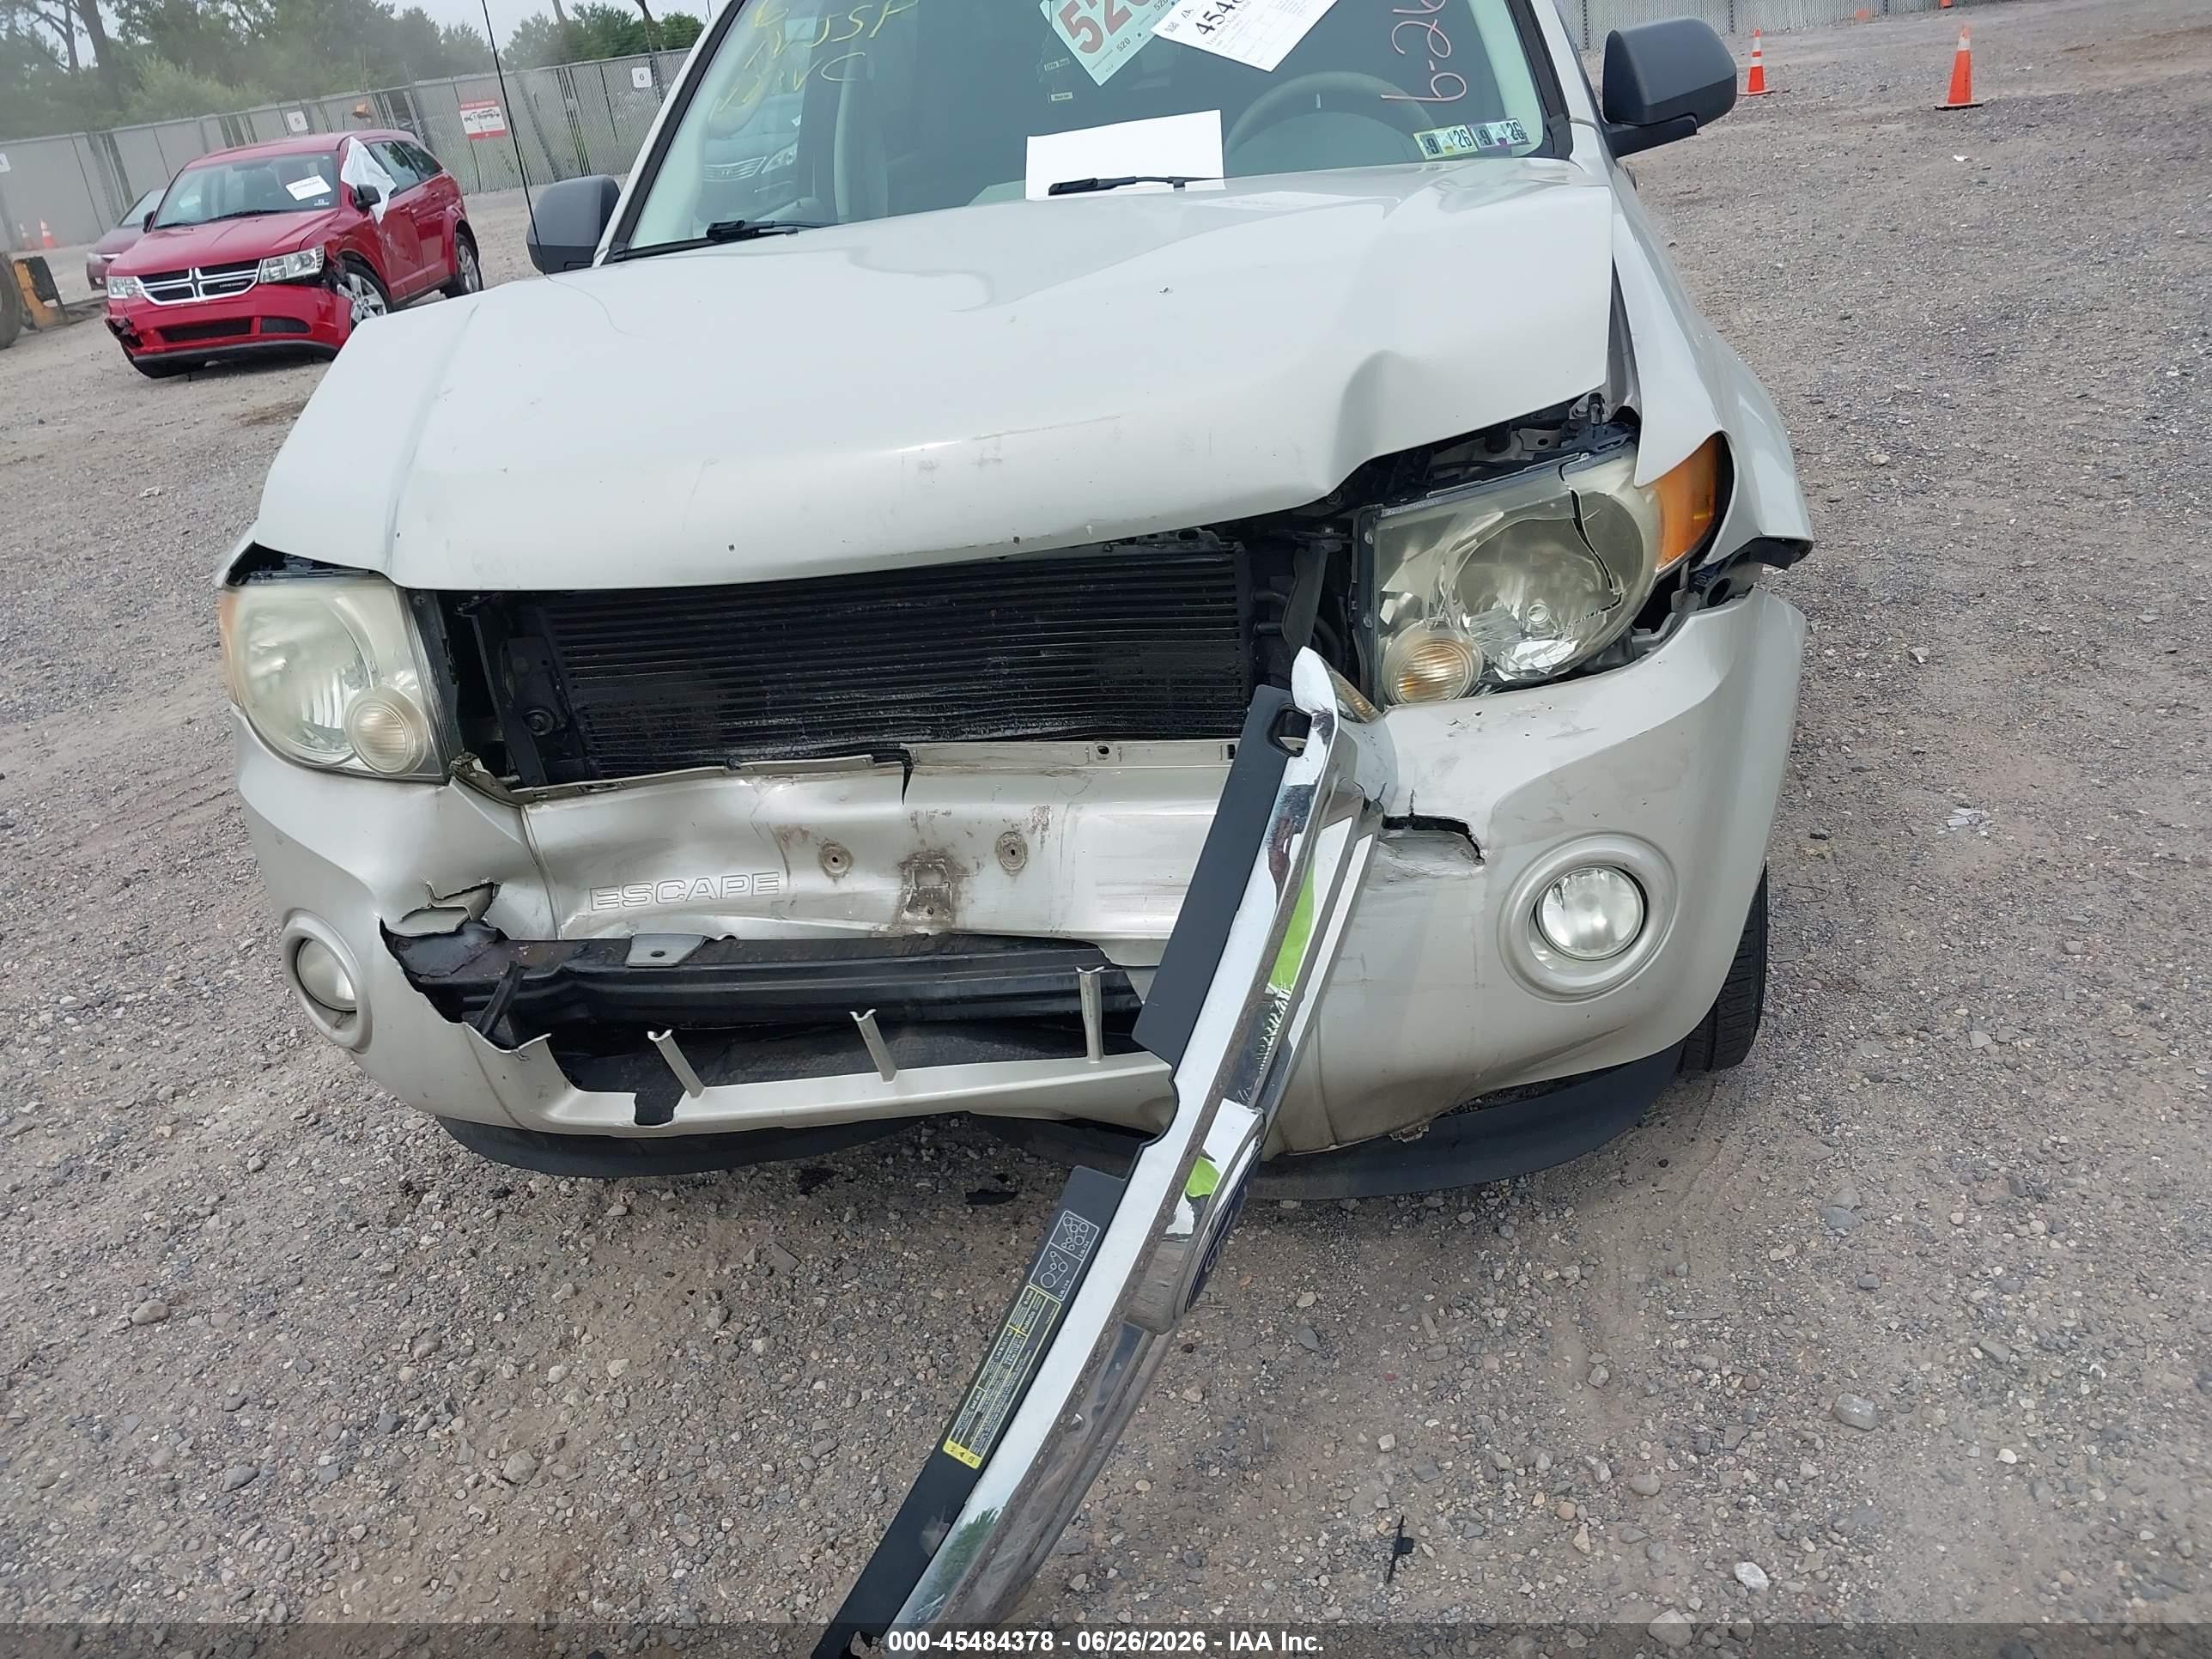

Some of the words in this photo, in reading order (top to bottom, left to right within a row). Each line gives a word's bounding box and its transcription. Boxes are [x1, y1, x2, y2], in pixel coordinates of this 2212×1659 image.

[1058, 0, 1149, 53] 52
[1115, 37, 1132, 52] 520
[1427, 137, 1439, 155] 9
[1453, 129, 1473, 149] 26
[1479, 130, 1492, 146] 9
[1506, 121, 1526, 141] 26
[589, 871, 781, 912] ESCAPE
